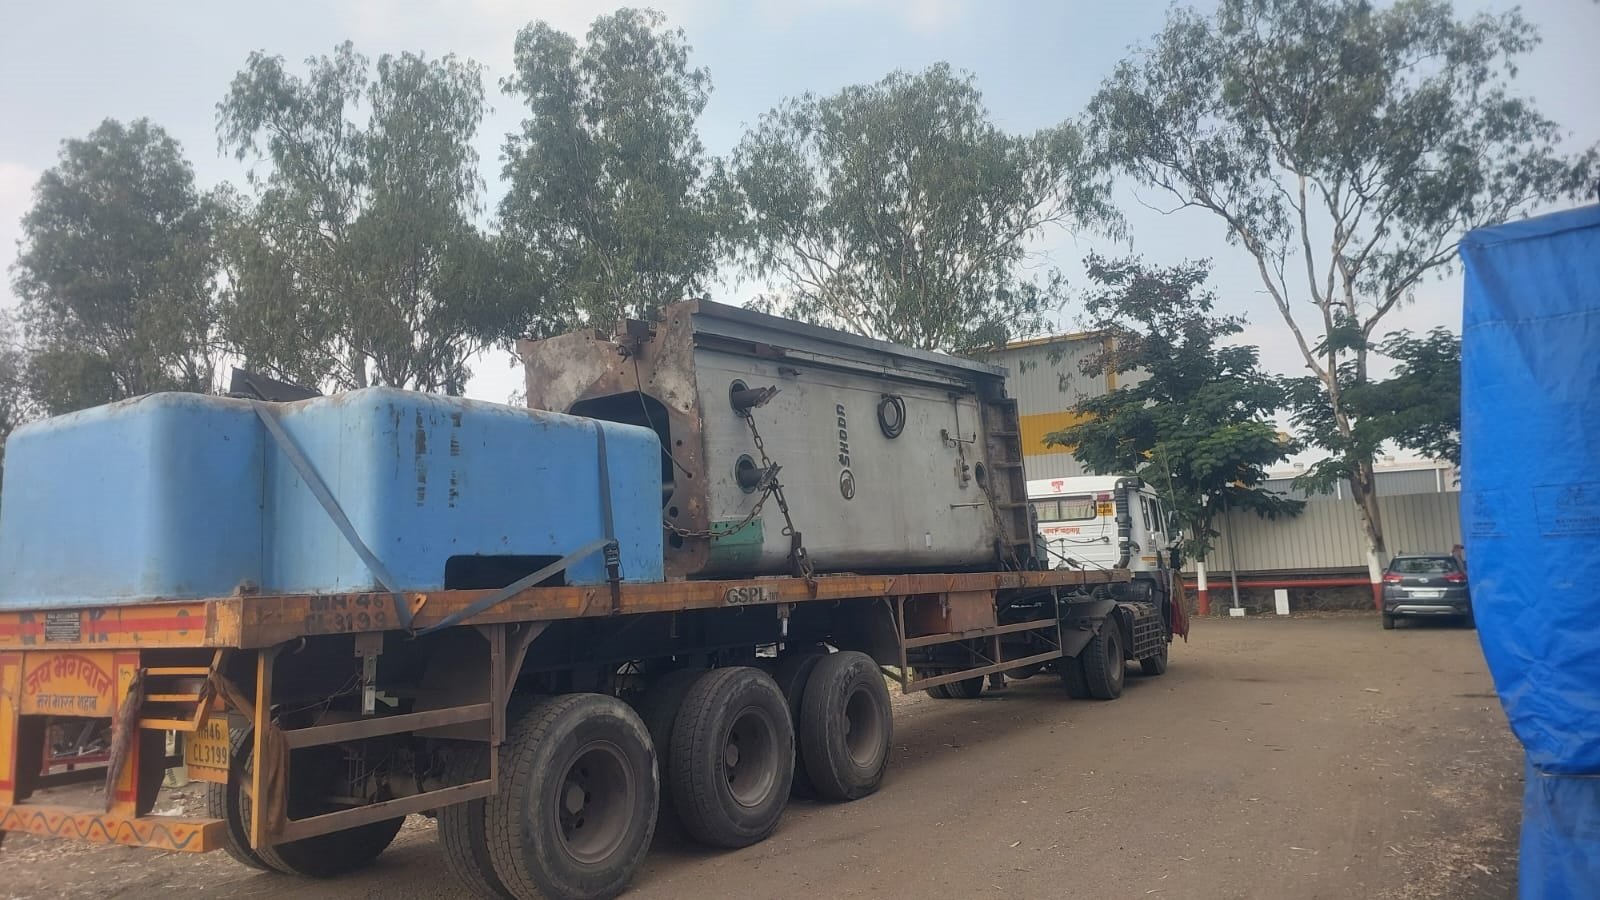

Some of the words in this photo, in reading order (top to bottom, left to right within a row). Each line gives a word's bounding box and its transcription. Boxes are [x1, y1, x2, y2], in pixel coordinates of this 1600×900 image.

[726, 586, 767, 604] GSPL
[26, 660, 51, 695] जय
[53, 653, 113, 697] भगवान
[193, 743, 228, 765] CL3199
